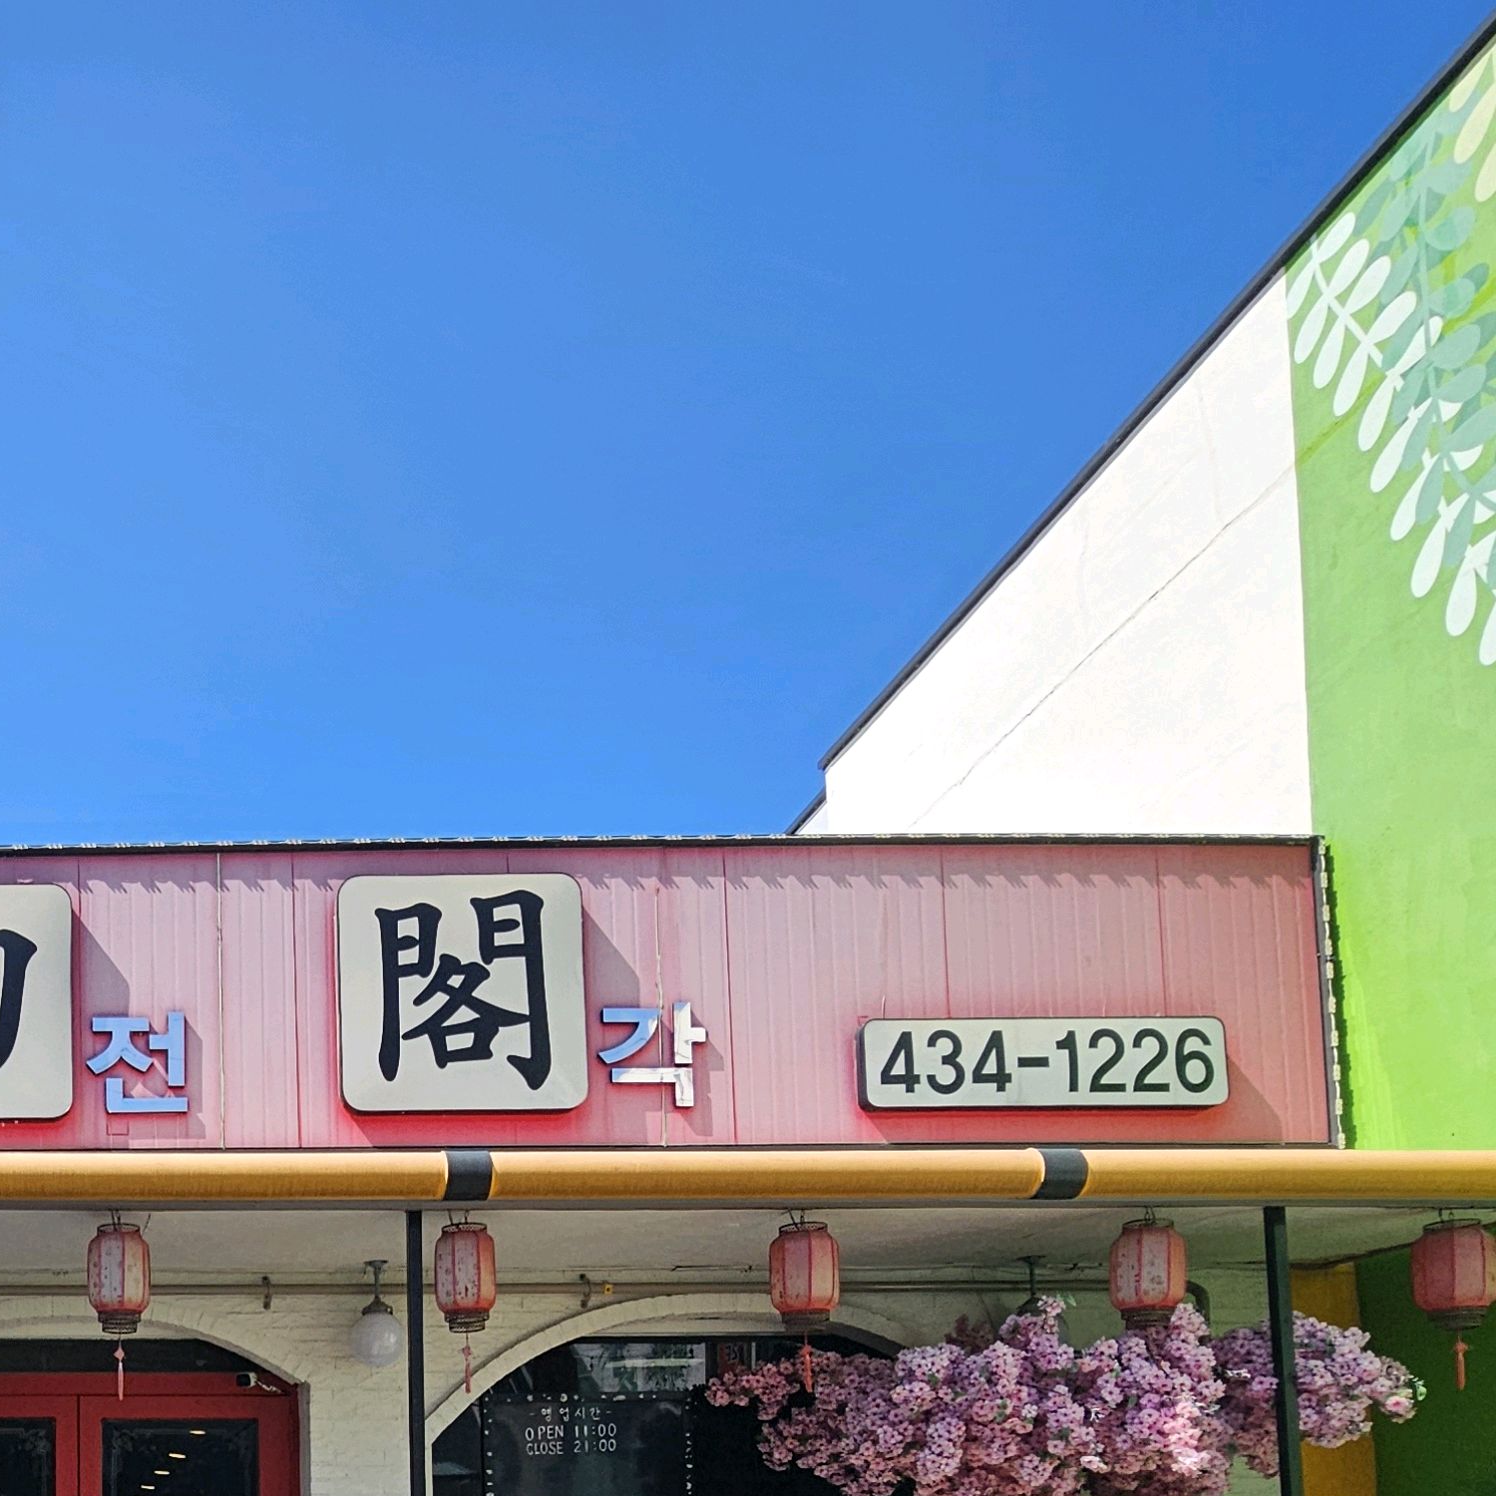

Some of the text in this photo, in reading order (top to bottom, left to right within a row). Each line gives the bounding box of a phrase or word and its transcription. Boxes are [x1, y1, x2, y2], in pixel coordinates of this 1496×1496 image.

[373, 889, 552, 1091] 閣
[87, 1011, 190, 1114] 전
[598, 1001, 708, 1108] 각
[880, 1028, 1215, 1095] 434-1226
[525, 1423, 617, 1441] OPEN 11:00
[526, 1439, 617, 1455] CLOSE 21:00
